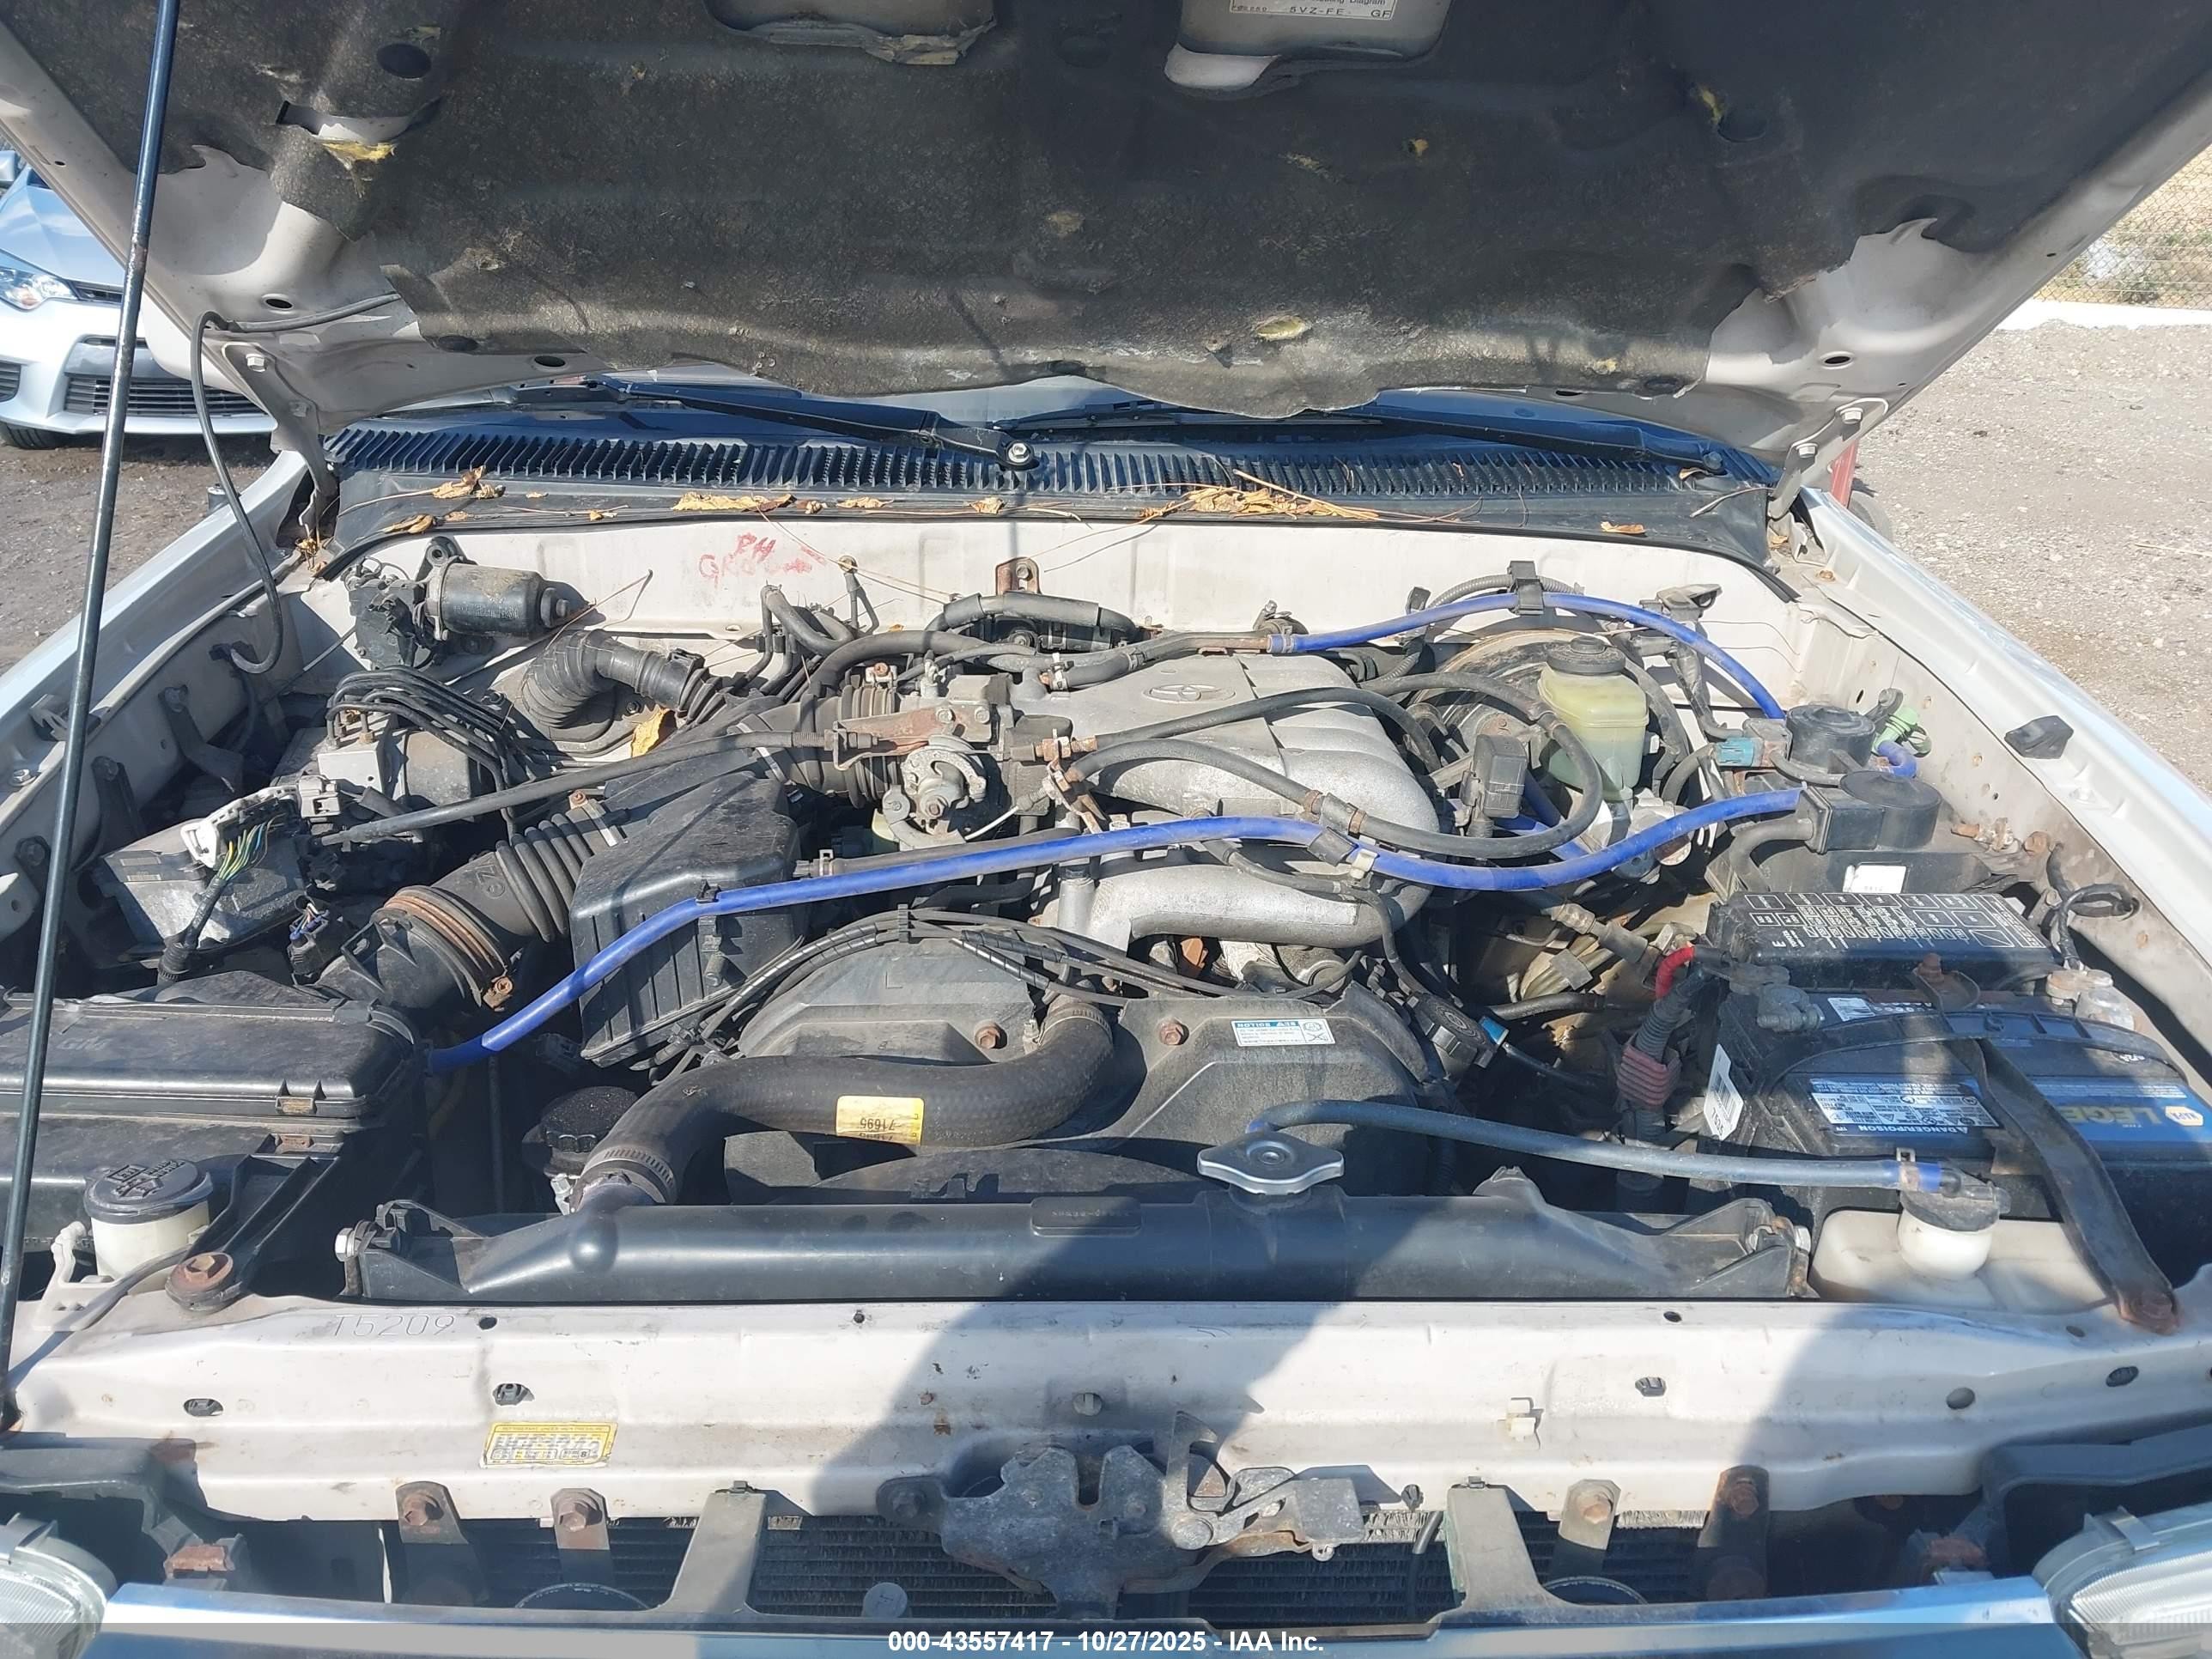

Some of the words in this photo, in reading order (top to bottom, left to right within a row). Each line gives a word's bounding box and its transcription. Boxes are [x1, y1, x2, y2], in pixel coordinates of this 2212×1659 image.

[1371, 9, 1391, 18] GF
[2058, 1106, 2162, 1124] LEGE
[860, 1117, 895, 1130] 71695
[335, 1314, 454, 1336] T5209
